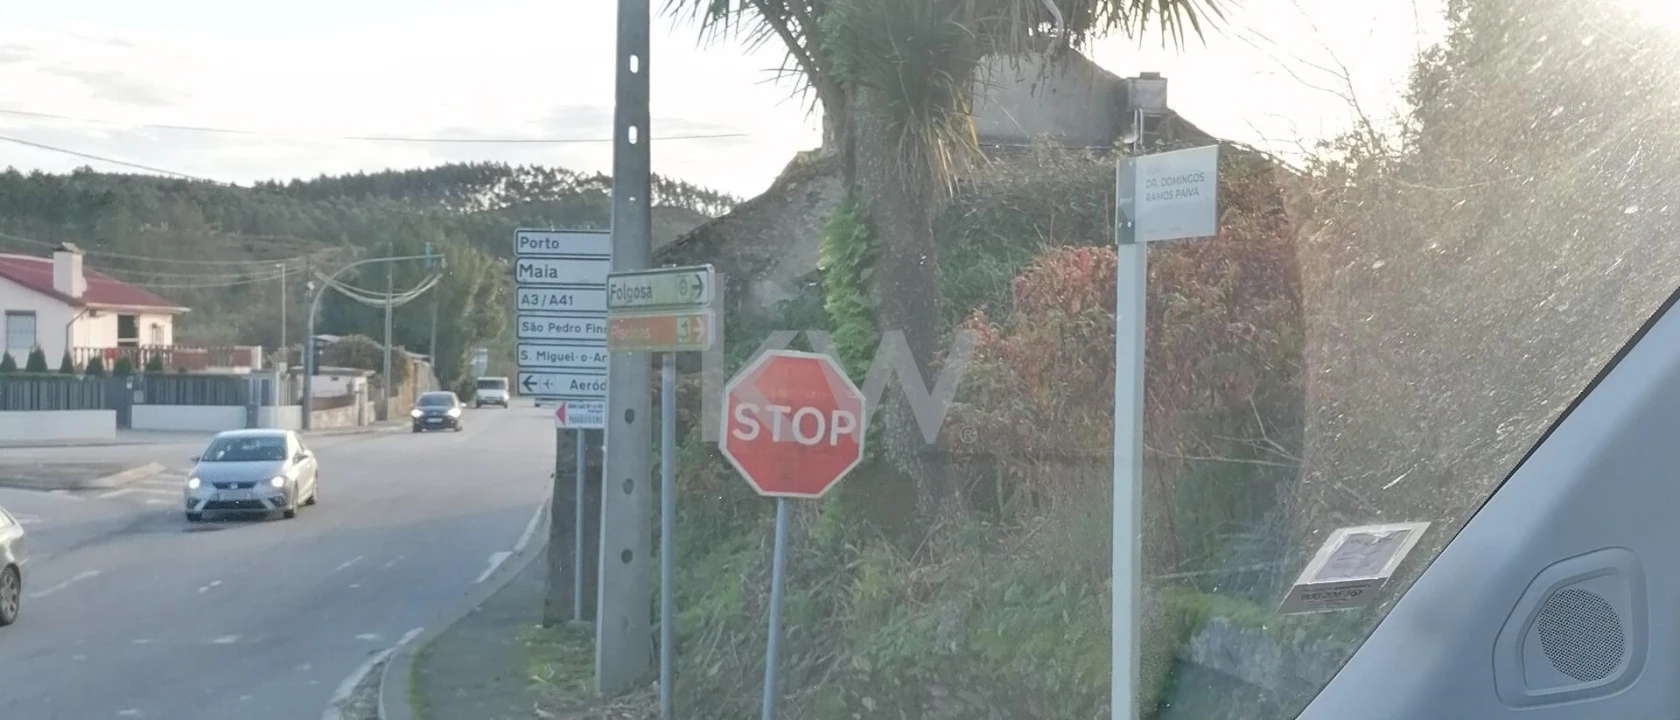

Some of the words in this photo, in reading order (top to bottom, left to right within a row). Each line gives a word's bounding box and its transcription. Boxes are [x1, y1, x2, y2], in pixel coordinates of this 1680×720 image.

[1161, 172, 1205, 187] DOMINGOS
[1146, 190, 1174, 202] RAMOS
[1175, 187, 1200, 199] PAIVA
[520, 236, 560, 250] Porto
[519, 264, 559, 279] Maia
[610, 282, 652, 303] Folgosa
[521, 321, 544, 333] São
[548, 321, 581, 333] Pedro
[732, 403, 856, 446] STOP
